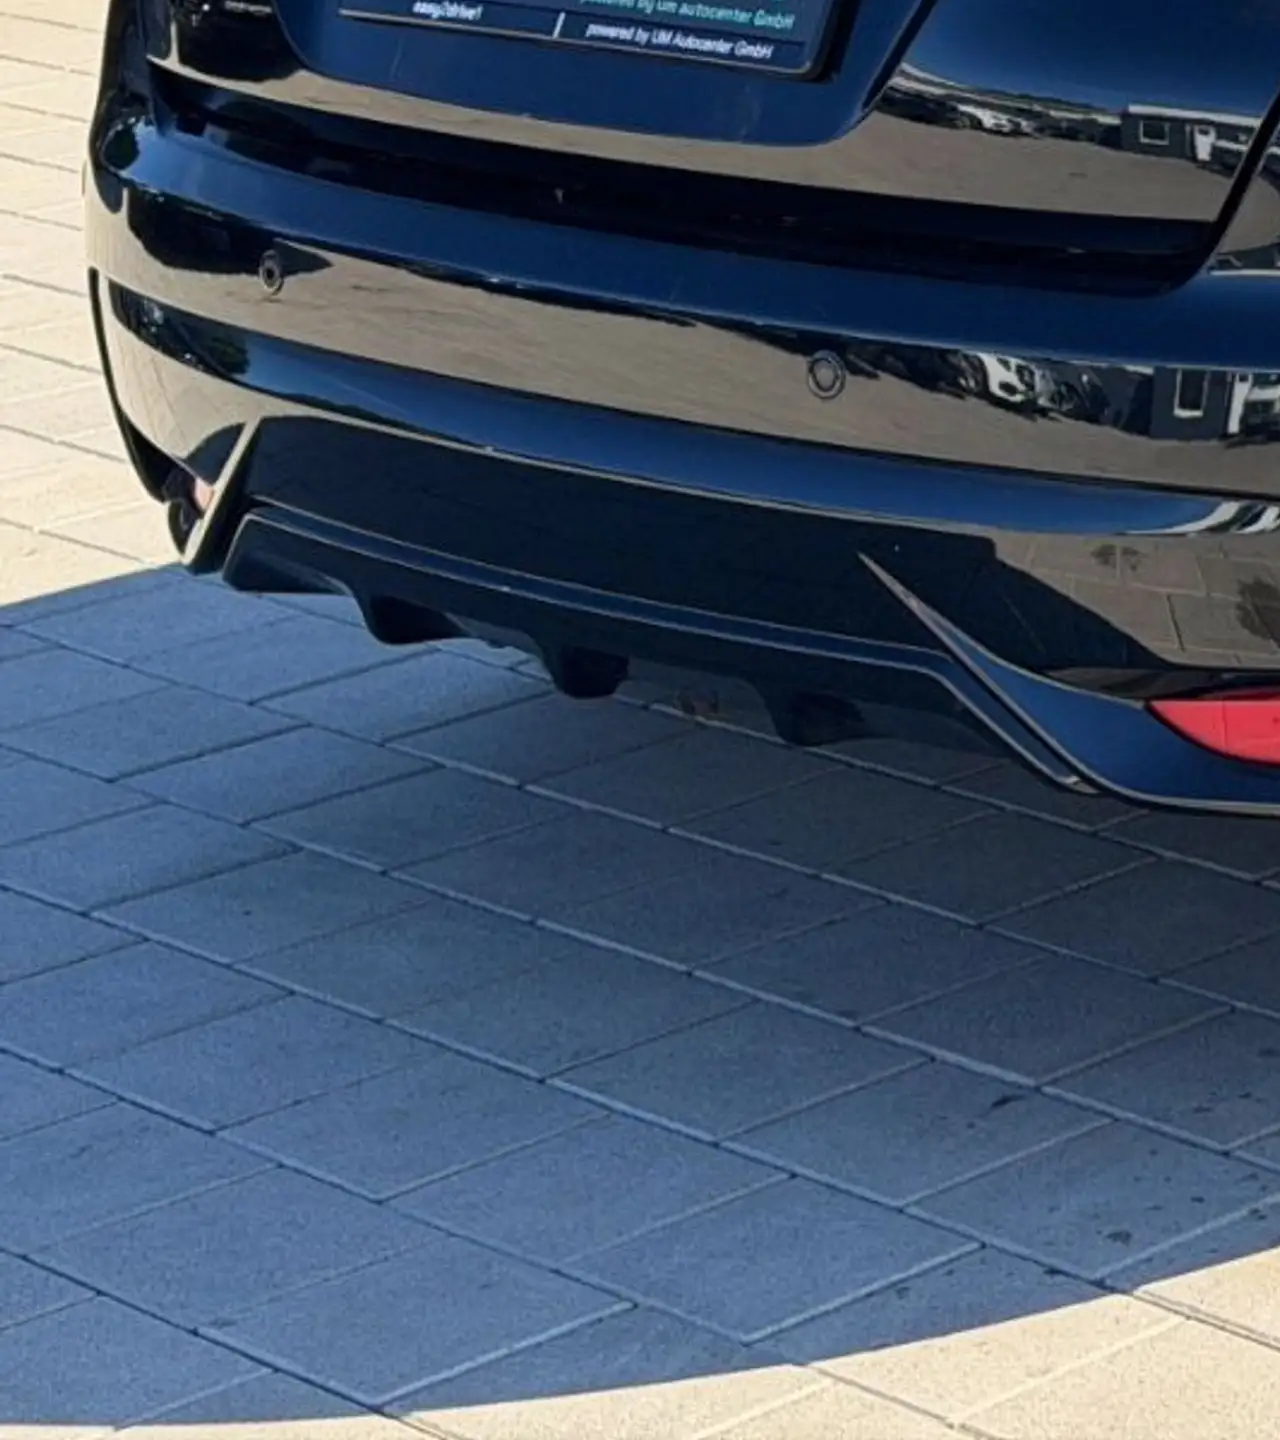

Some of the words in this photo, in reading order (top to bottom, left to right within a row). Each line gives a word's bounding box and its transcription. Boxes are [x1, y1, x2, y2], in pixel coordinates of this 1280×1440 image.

[753, 9, 795, 29] GmbH
[585, 23, 636, 40] powered
[635, 28, 651, 46] by
[651, 29, 673, 45] UM
[672, 33, 734, 55] Autocenter
[733, 40, 775, 59] GmbH
